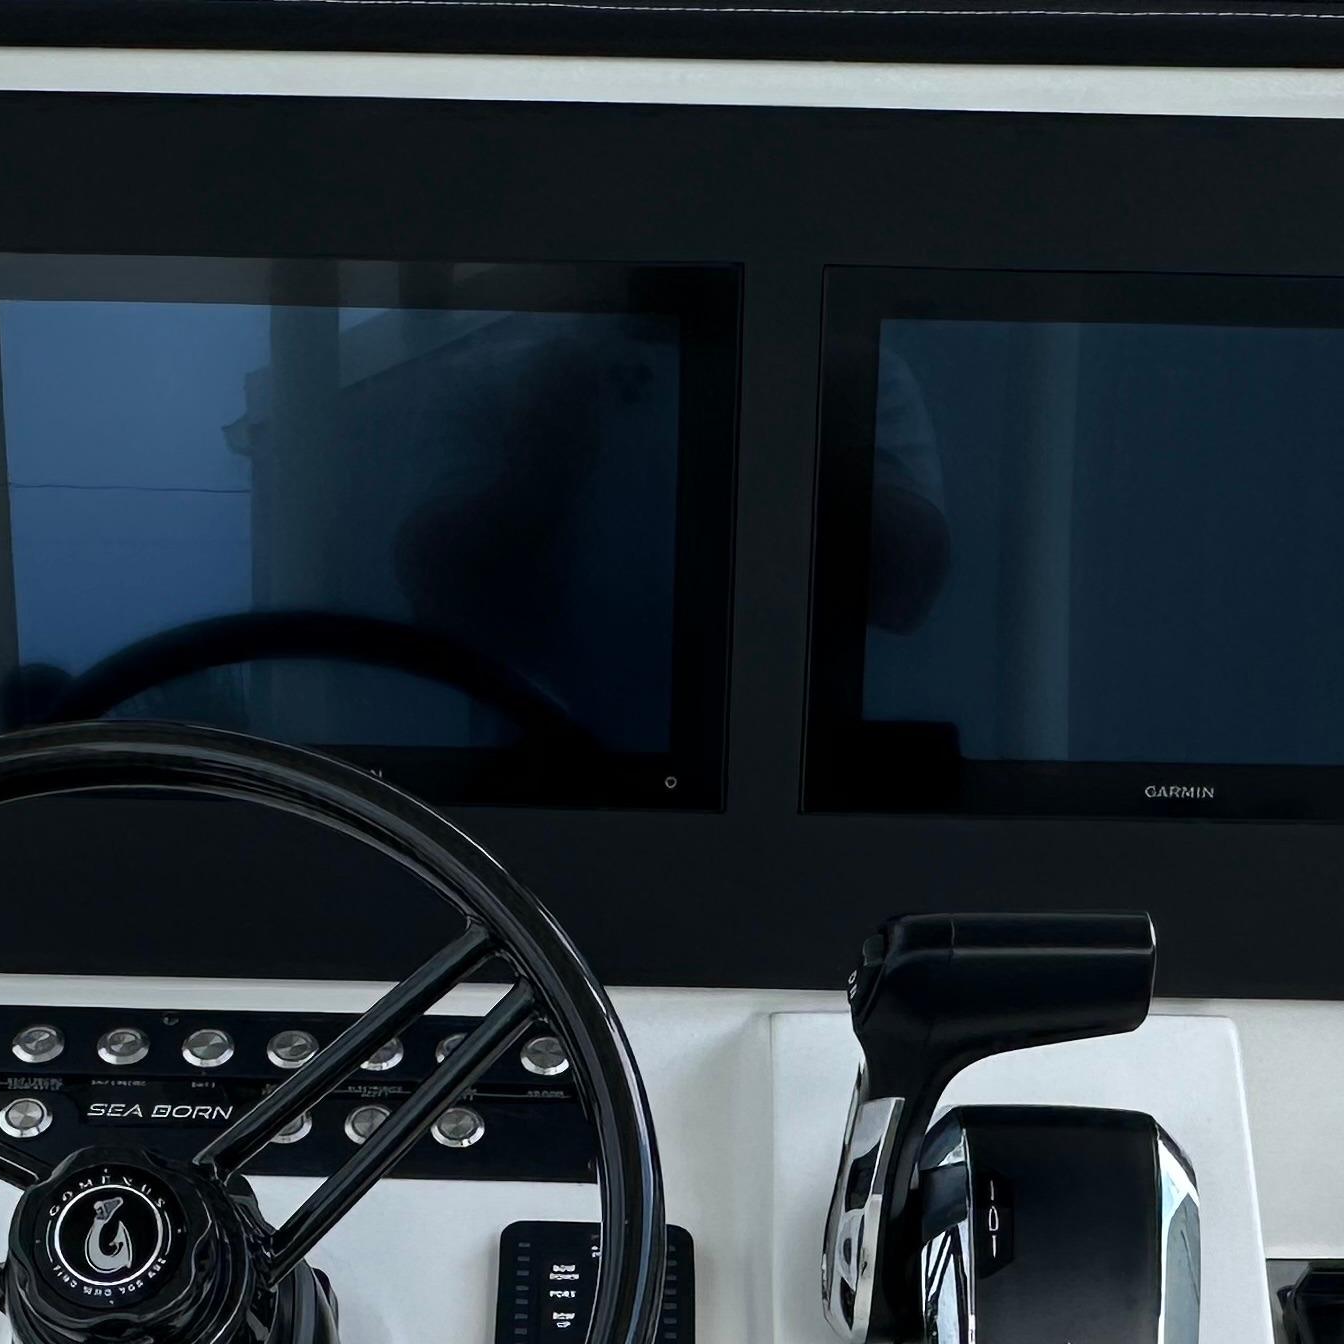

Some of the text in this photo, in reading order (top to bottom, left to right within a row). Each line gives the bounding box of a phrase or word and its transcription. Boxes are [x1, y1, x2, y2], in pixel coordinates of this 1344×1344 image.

[1144, 785, 1215, 799] GARMIN
[87, 1103, 234, 1119] SEA BORN
